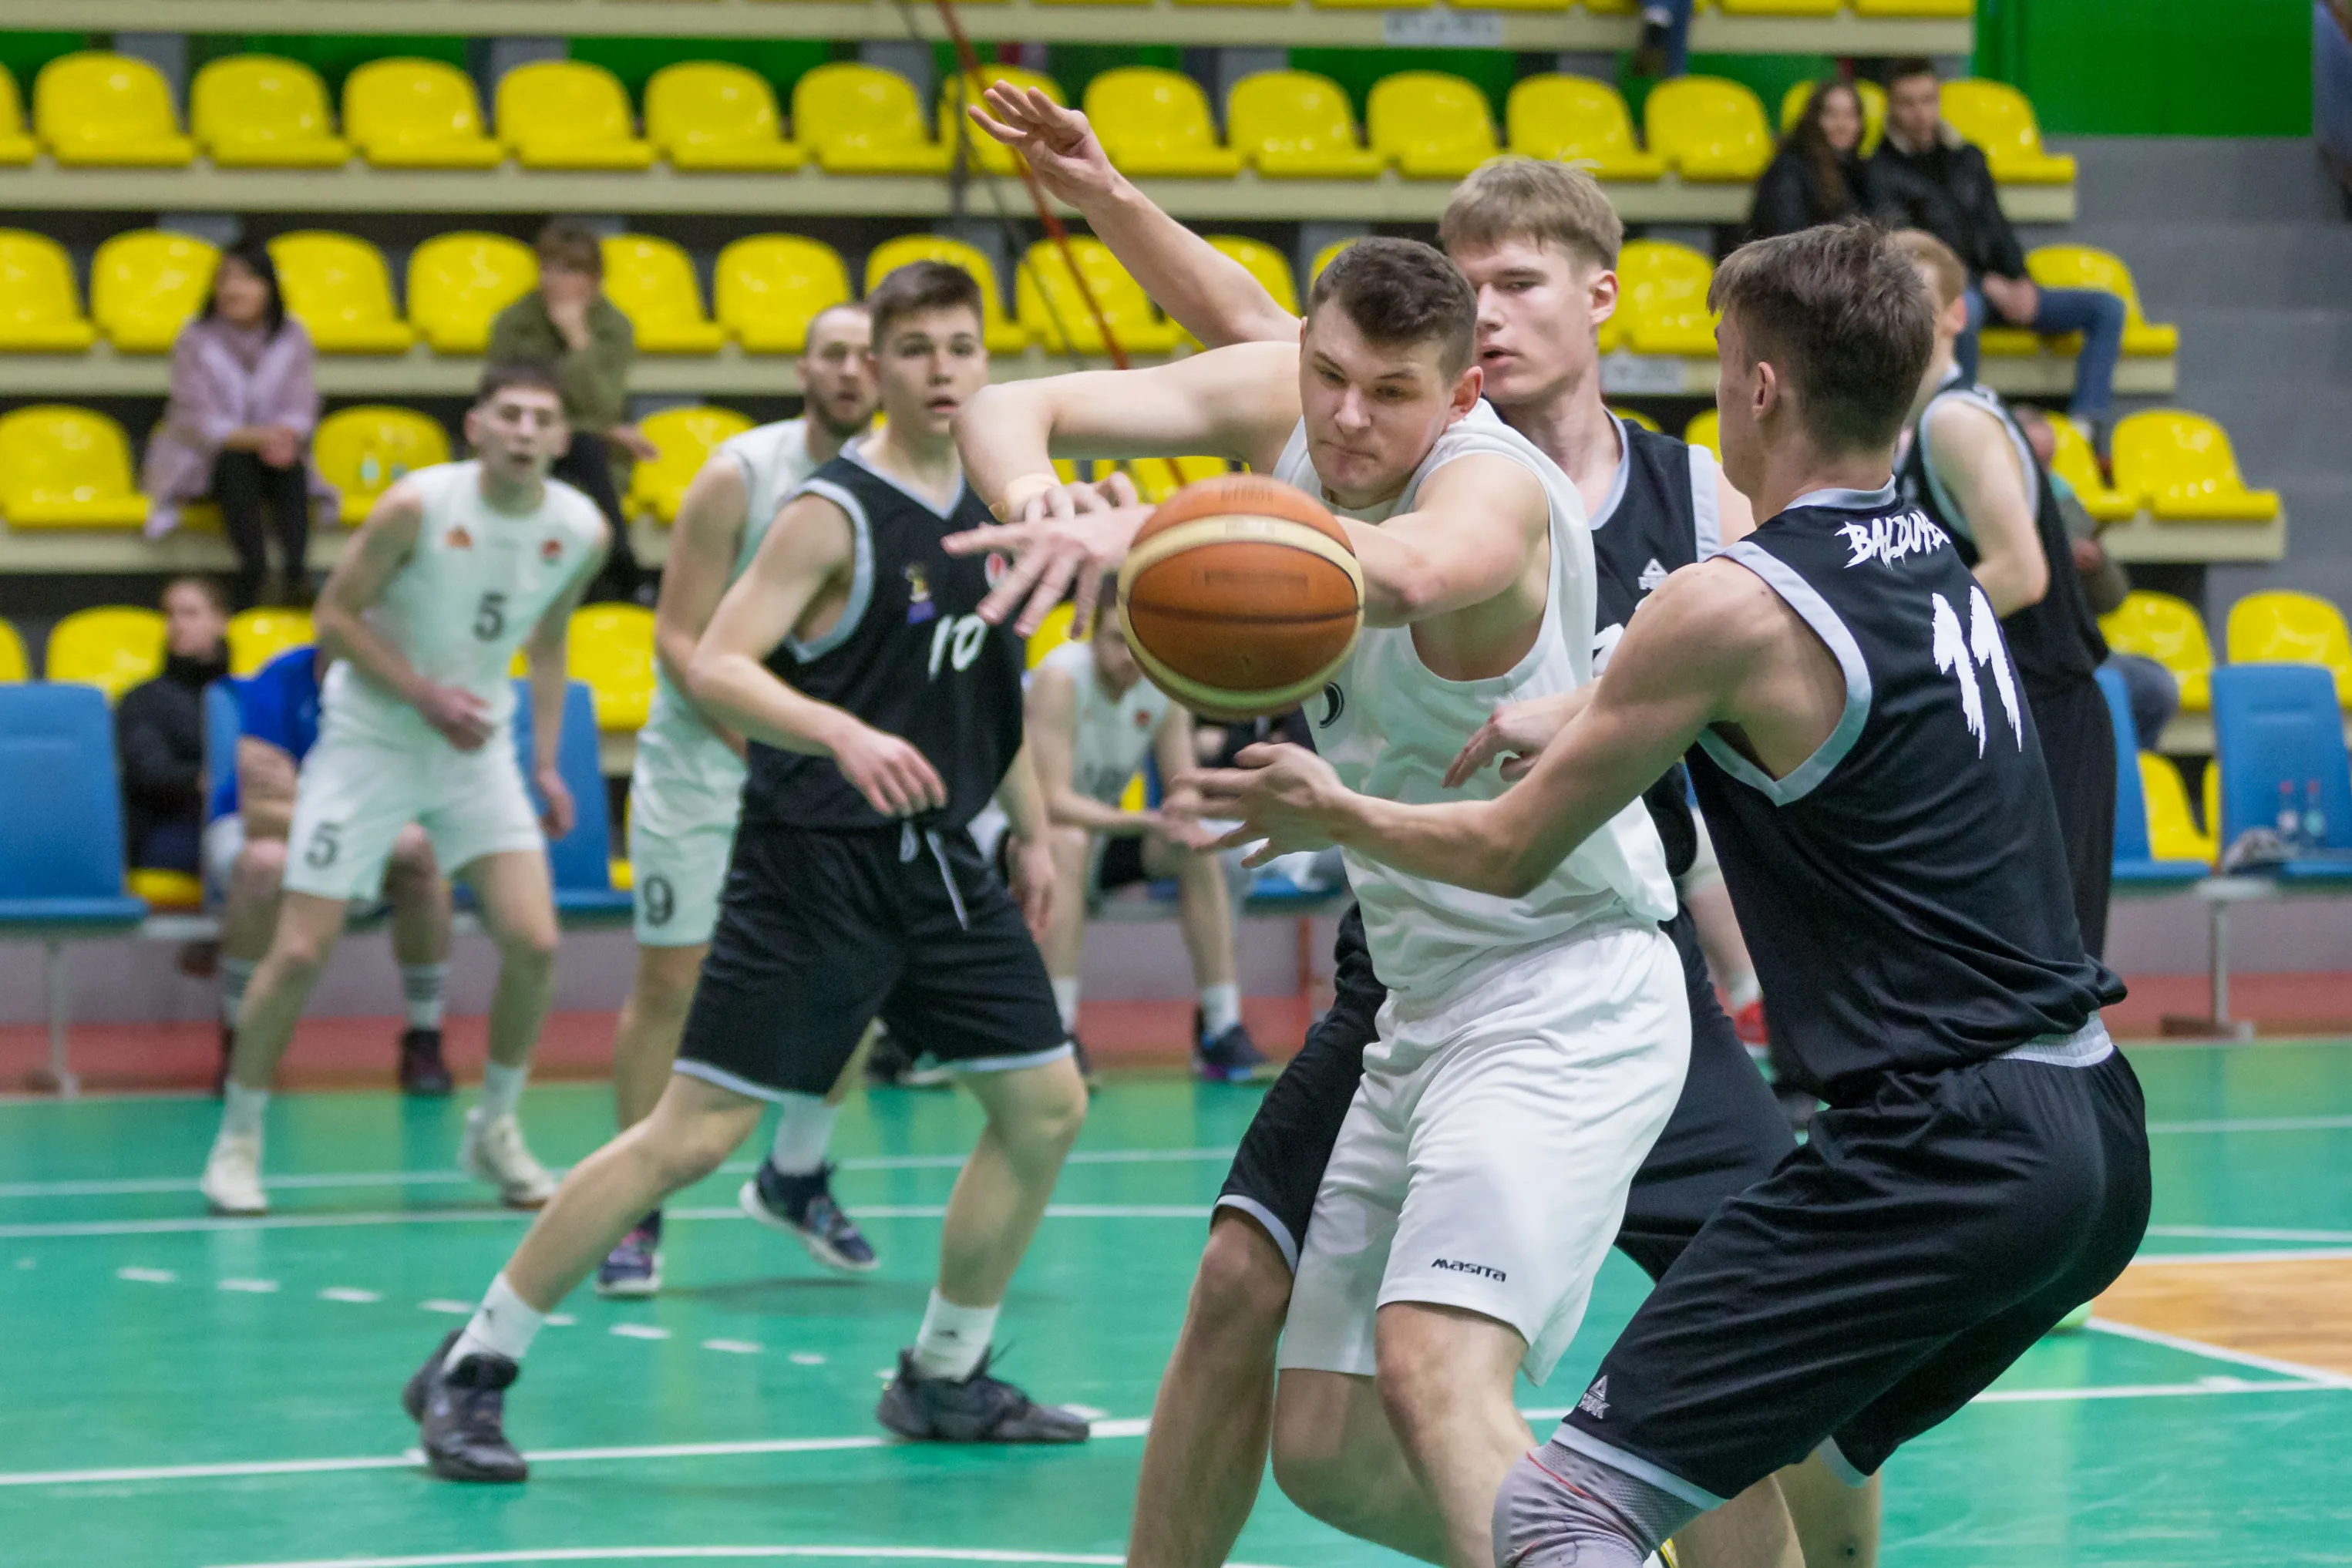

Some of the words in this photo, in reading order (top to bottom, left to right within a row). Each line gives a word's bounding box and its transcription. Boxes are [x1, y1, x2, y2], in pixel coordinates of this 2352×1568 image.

[473, 591, 506, 641] 5
[928, 614, 988, 681] 10
[1931, 586, 2022, 759] 11
[305, 821, 344, 870] 5
[643, 873, 675, 927] 9
